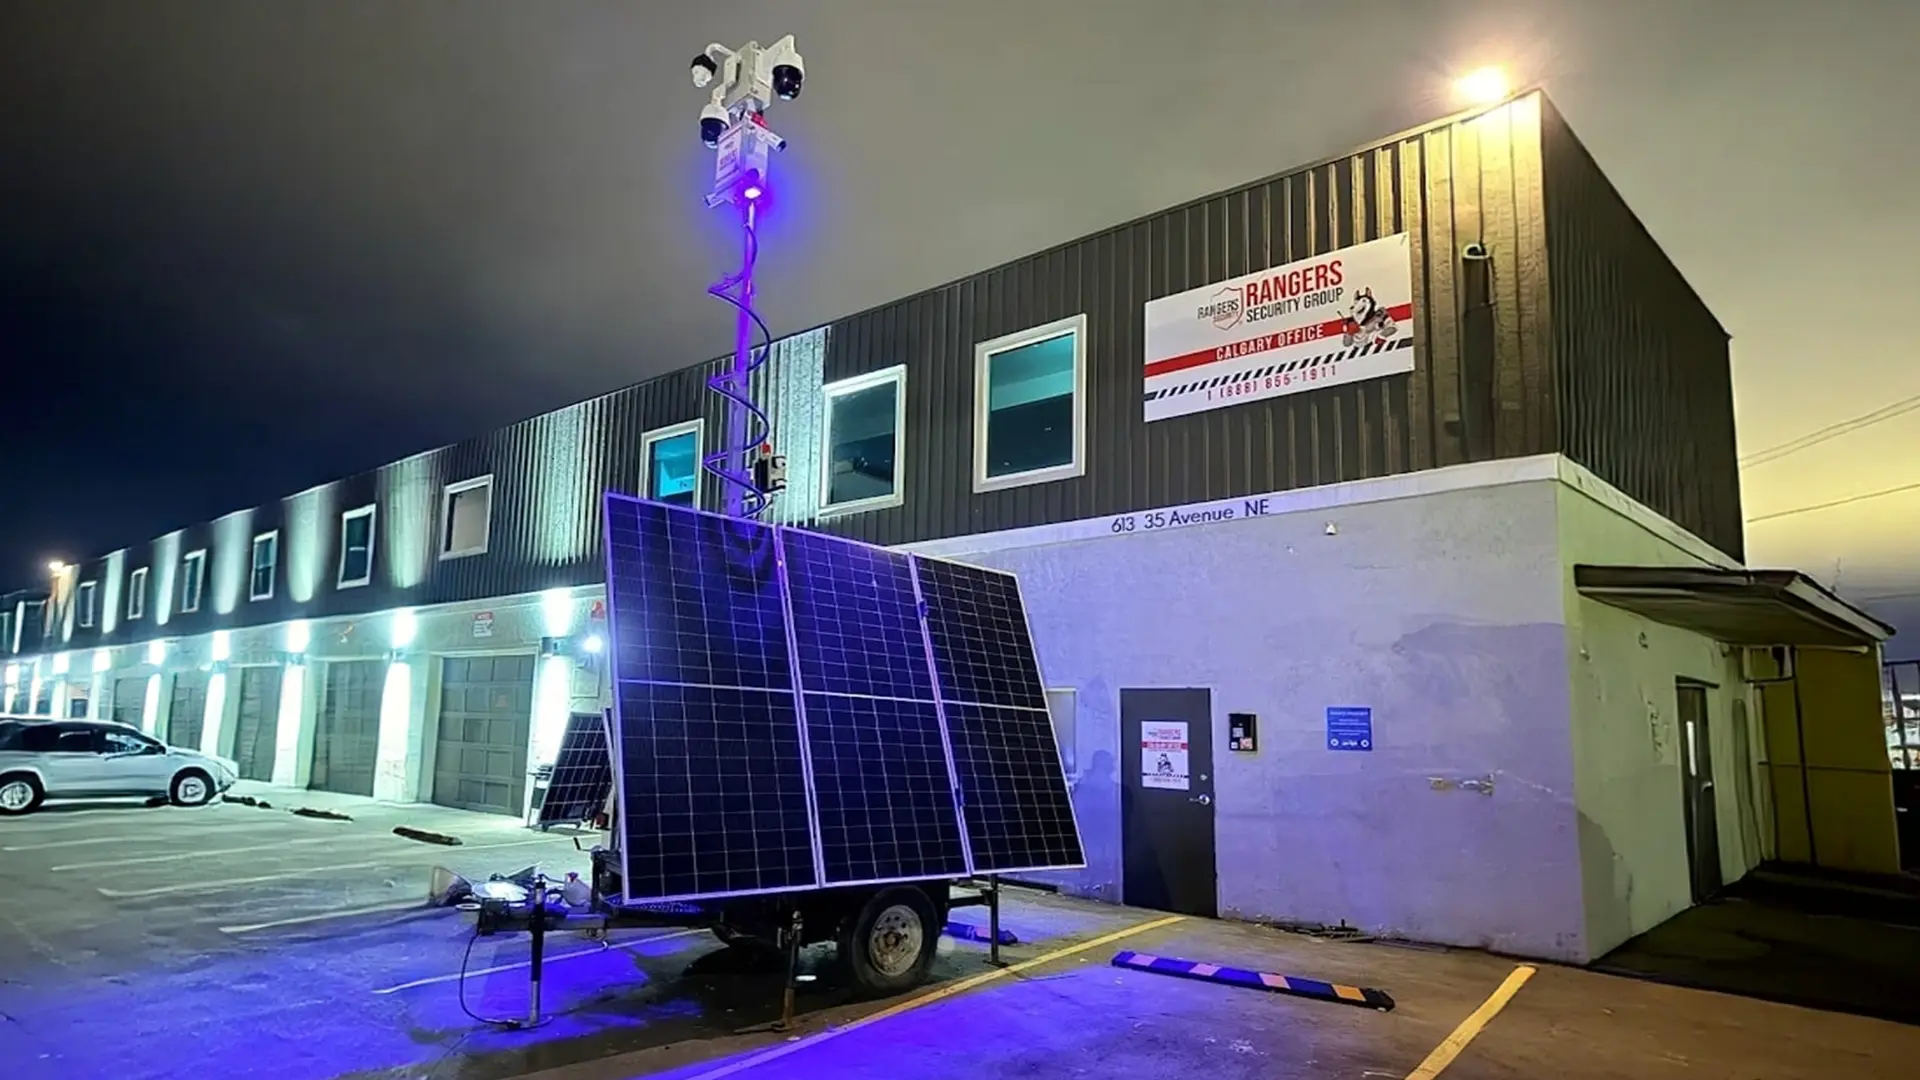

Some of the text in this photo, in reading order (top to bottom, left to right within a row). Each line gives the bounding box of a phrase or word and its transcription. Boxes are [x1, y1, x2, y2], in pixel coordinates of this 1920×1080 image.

[1246, 260, 1343, 307] RANGERS
[1246, 287, 1344, 323] SECURITY GROUP
[1216, 325, 1324, 360] CALGARY OFFICE
[1265, 364, 1336, 390] 855-1911
[1111, 499, 1269, 533] 613 35 Avenue NE
